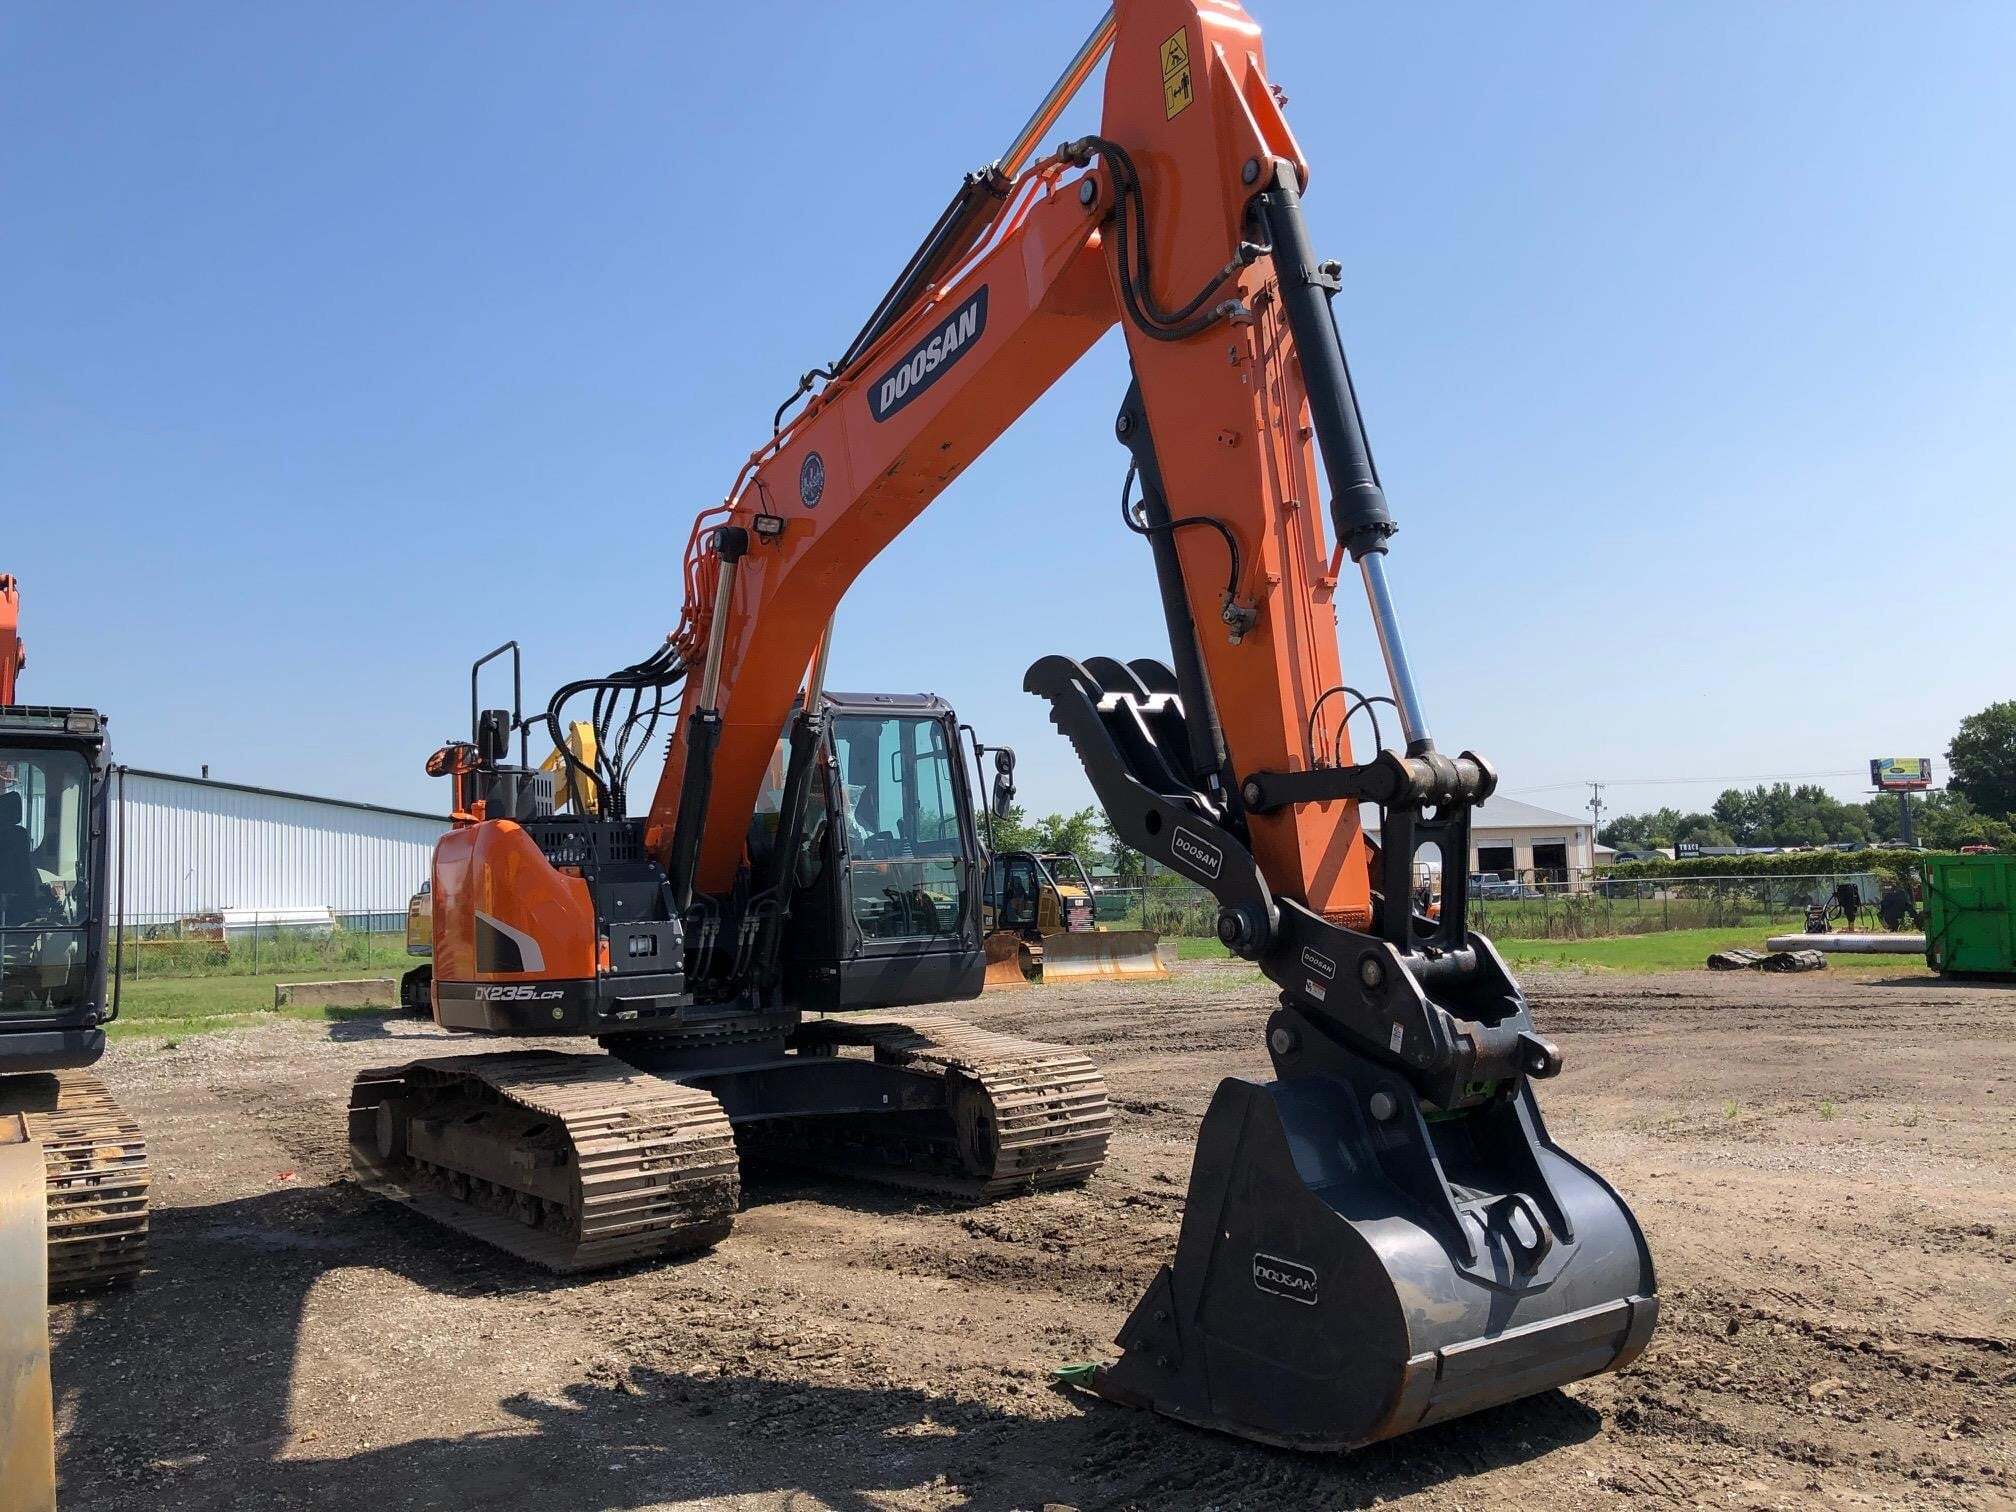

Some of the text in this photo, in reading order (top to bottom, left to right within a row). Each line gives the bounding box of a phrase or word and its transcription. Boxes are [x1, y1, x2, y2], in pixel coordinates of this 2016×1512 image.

[880, 302, 977, 413] DOOSAN
[1175, 838, 1218, 868] DOOSAN
[1304, 953, 1333, 973] DOOSAN
